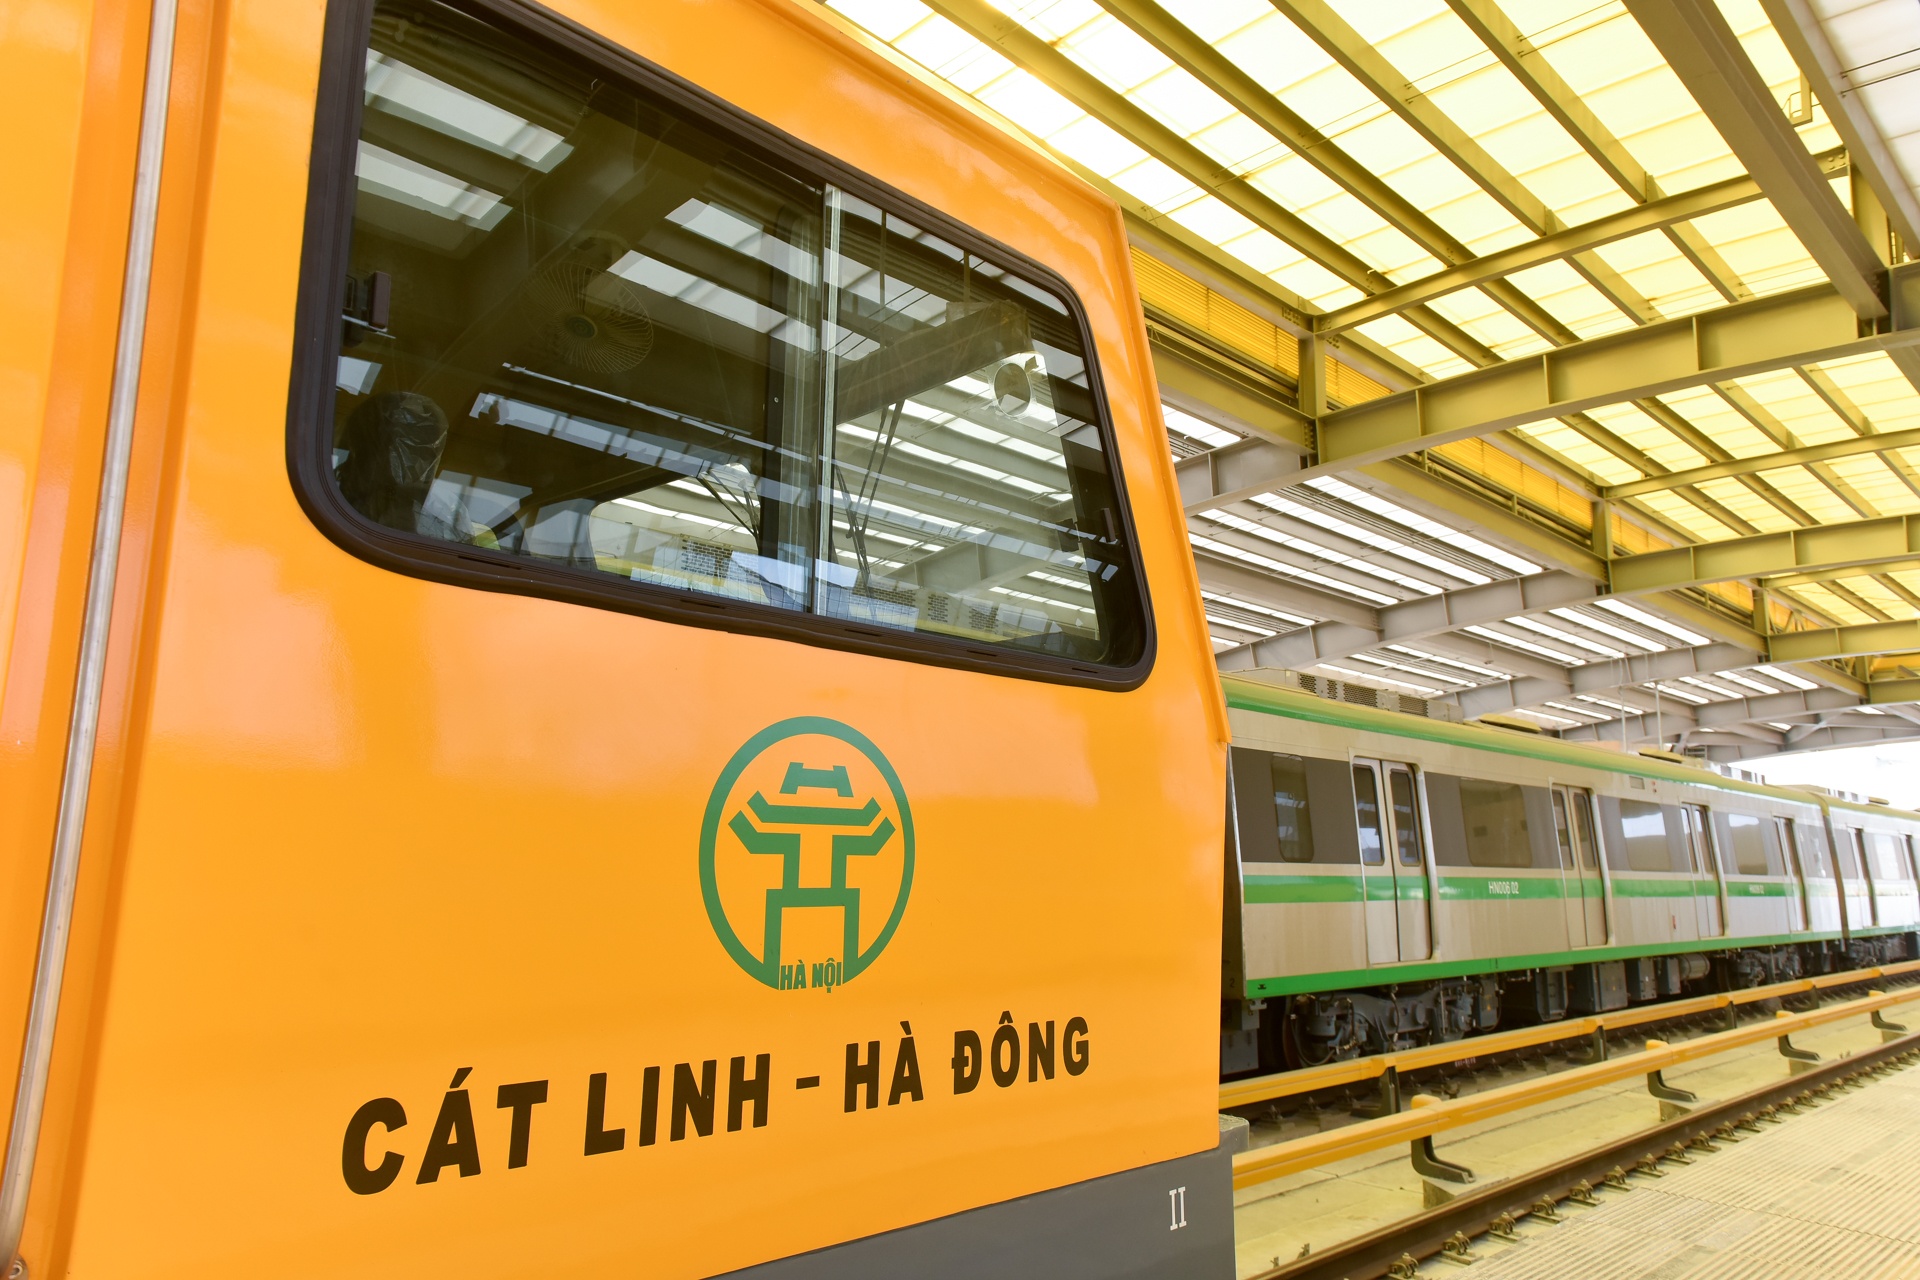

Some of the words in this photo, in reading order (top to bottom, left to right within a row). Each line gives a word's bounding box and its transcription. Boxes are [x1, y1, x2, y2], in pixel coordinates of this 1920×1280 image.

[780, 959, 806, 990] HÀ
[812, 957, 842, 993] NỘI
[342, 1066, 548, 1196] CÁT
[583, 1053, 771, 1157] LINH
[795, 1075, 820, 1090] -
[843, 1020, 924, 1114] HÀ
[951, 1010, 1090, 1095] ĐÔNG
